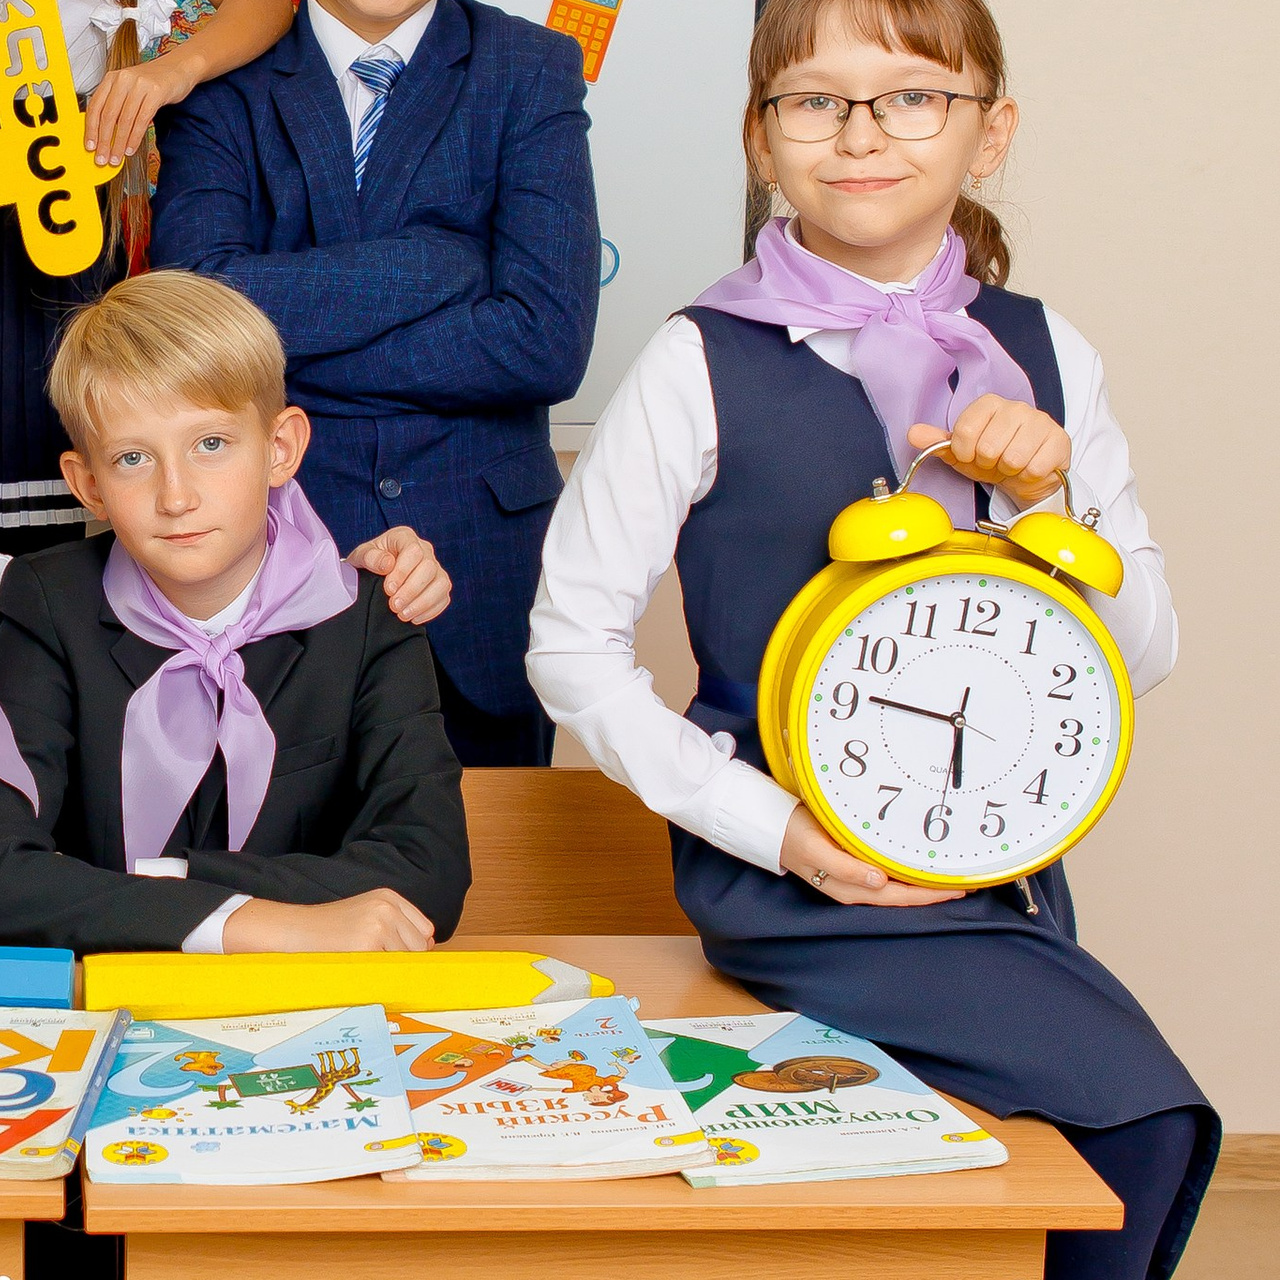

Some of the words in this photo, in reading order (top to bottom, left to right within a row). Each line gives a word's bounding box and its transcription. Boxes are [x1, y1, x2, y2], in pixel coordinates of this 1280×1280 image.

[900, 600, 938, 639] 11
[953, 597, 1001, 637] 12
[851, 634, 898, 675] 10
[1019, 619, 1039, 656] 1
[829, 681, 860, 721] 9
[1048, 663, 1077, 701] 2
[1055, 718, 1084, 757] 3
[839, 739, 869, 778] 8
[877, 784, 903, 821] 7
[1022, 769, 1049, 806] 4
[923, 804, 953, 843] 6
[980, 800, 1008, 838] 5
[595, 1017, 620, 1030] 2
[124, 1114, 381, 1138] Математика
[493, 1103, 673, 1130] Русский
[700, 1108, 940, 1135] Окружающий
